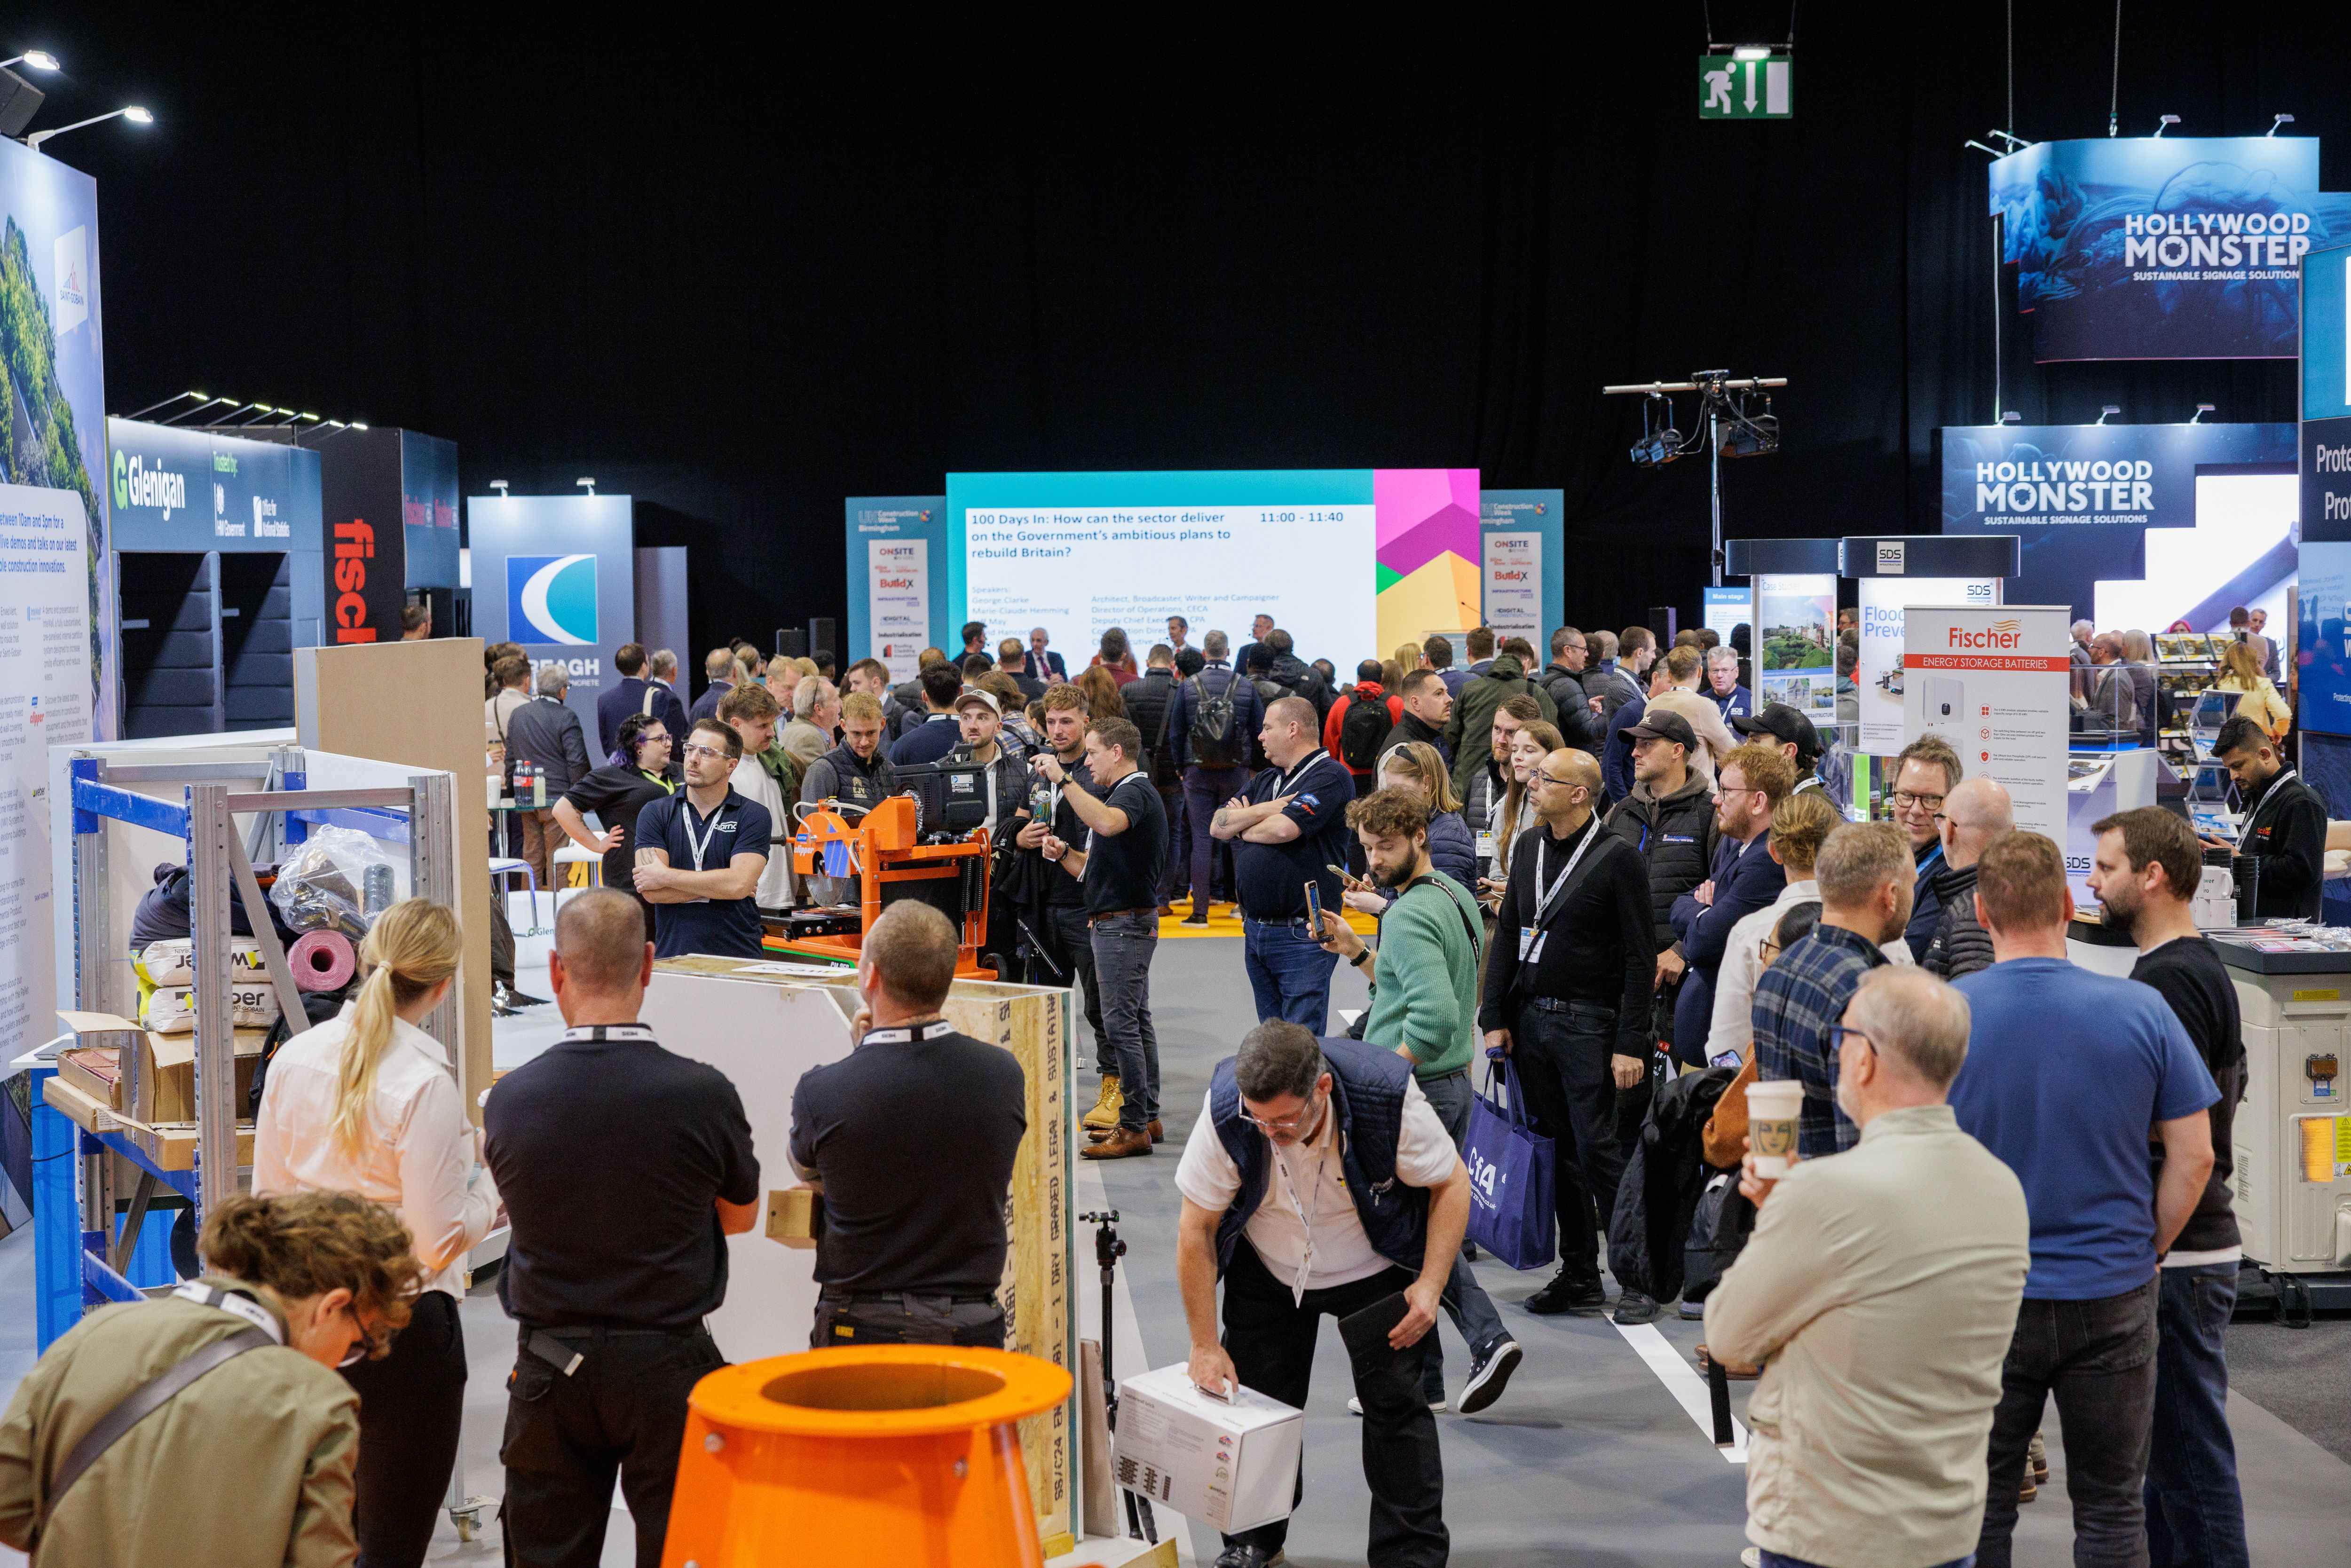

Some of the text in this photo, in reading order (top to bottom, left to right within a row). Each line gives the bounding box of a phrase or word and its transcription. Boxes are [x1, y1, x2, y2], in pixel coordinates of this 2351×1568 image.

[2125, 213, 2310, 235] HOLLYWOOD
[2125, 235, 2310, 267] MONSTER
[2133, 270, 2299, 281] SUSTAINABLE SIGNAGE SOLUTION
[60, 290, 84, 306] SAINT-GOBAIN
[213, 450, 230, 473] Trusted
[1977, 460, 2154, 482] HOLLYWOOD
[128, 455, 185, 521] Glenigan
[1977, 481, 2154, 512] MONSTER
[2325, 491, 2351, 520] Pro
[19, 512, 31, 527] 10am
[32, 513, 41, 528] and
[42, 514, 52, 530] 3pm
[61, 519, 63, 529] a
[972, 514, 994, 524] 100
[1000, 515, 1029, 526] Days
[1033, 515, 1049, 524] In:
[1054, 514, 1082, 524] How
[1113, 514, 1133, 523] the
[1138, 514, 1176, 523] sector
[1181, 513, 1225, 523] deliver
[1261, 512, 1344, 522] 11:00 11:40
[1984, 514, 2147, 525] SUSTAINABLE SIGNAGE SOLUTIONS
[224, 520, 245, 536] Government
[858, 525, 900, 534] Birmingham
[992, 531, 1013, 541] the
[1018, 530, 1108, 541] Government’s
[1112, 530, 1176, 540] ambitious
[1180, 529, 1214, 541] plans
[10, 535, 26, 550] demos
[28, 536, 36, 550] and
[38, 536, 48, 550] talks
[49, 540, 55, 551] on
[65, 537, 77, 551] latest
[972, 547, 1072, 558] rebuild Britain?
[1879, 549, 1901, 559] SDS
[8, 559, 66, 573] construction innovations.
[1763, 580, 1800, 591] Case Studies
[1967, 585, 1991, 595] SDS
[972, 597, 1002, 605] George
[1231, 594, 1279, 603] Campaigner
[1949, 627, 2021, 648] Fischer
[1923, 657, 2048, 669] ENERGY STORAGE BATTERIES
[30, 711, 45, 727] clipper
[35, 787, 45, 796] weber
[794, 844, 814, 857] clipper
[537, 927, 554, 936] Glen
[1049, 1113, 1058, 1168] LEGAL
[1468, 1146, 1496, 1196] CfA
[1049, 1176, 1060, 1242] GRADED
[1051, 1253, 1061, 1285] DRY
[1054, 1435, 1063, 1502] SS/C24
